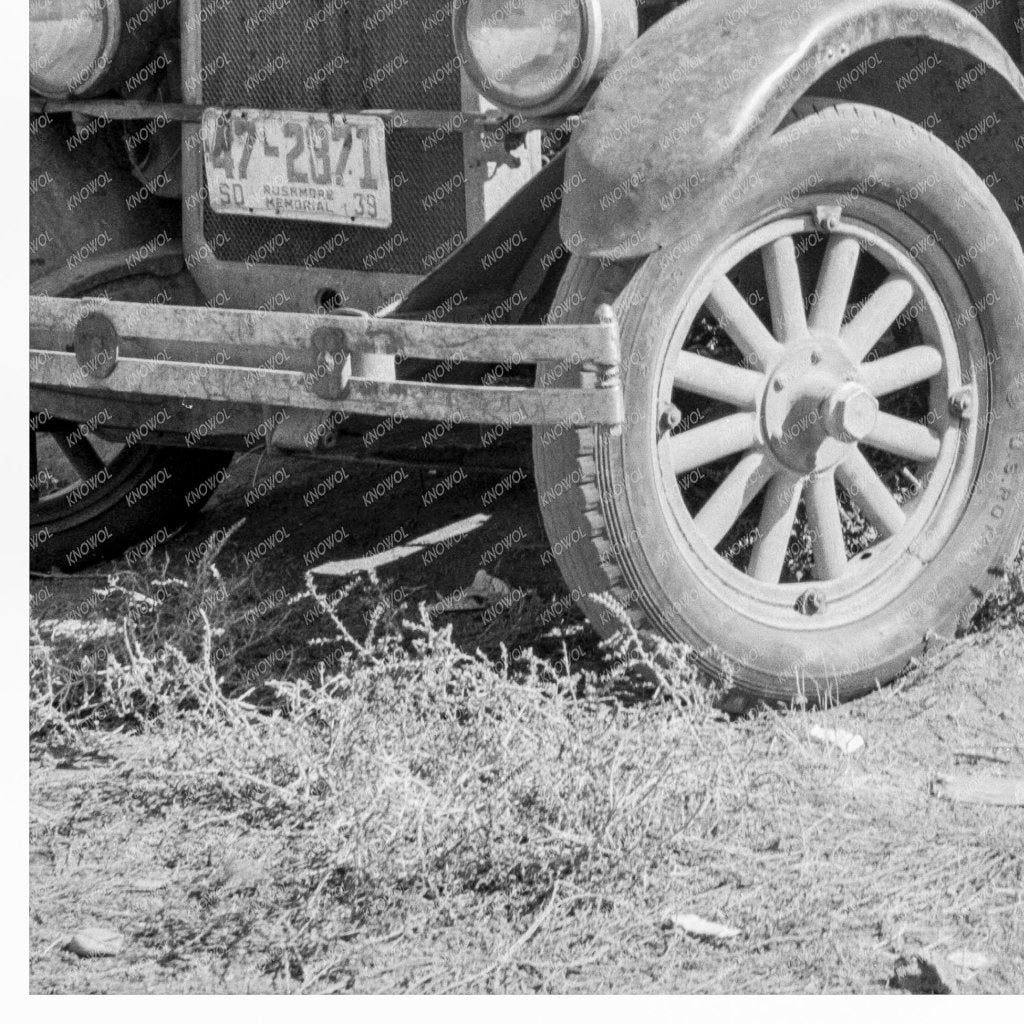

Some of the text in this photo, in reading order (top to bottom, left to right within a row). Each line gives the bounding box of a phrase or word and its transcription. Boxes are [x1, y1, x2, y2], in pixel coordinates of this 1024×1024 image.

[219, 182, 245, 206] SD
[265, 198, 335, 214] MEMORIAL
[352, 192, 378, 219] 39
